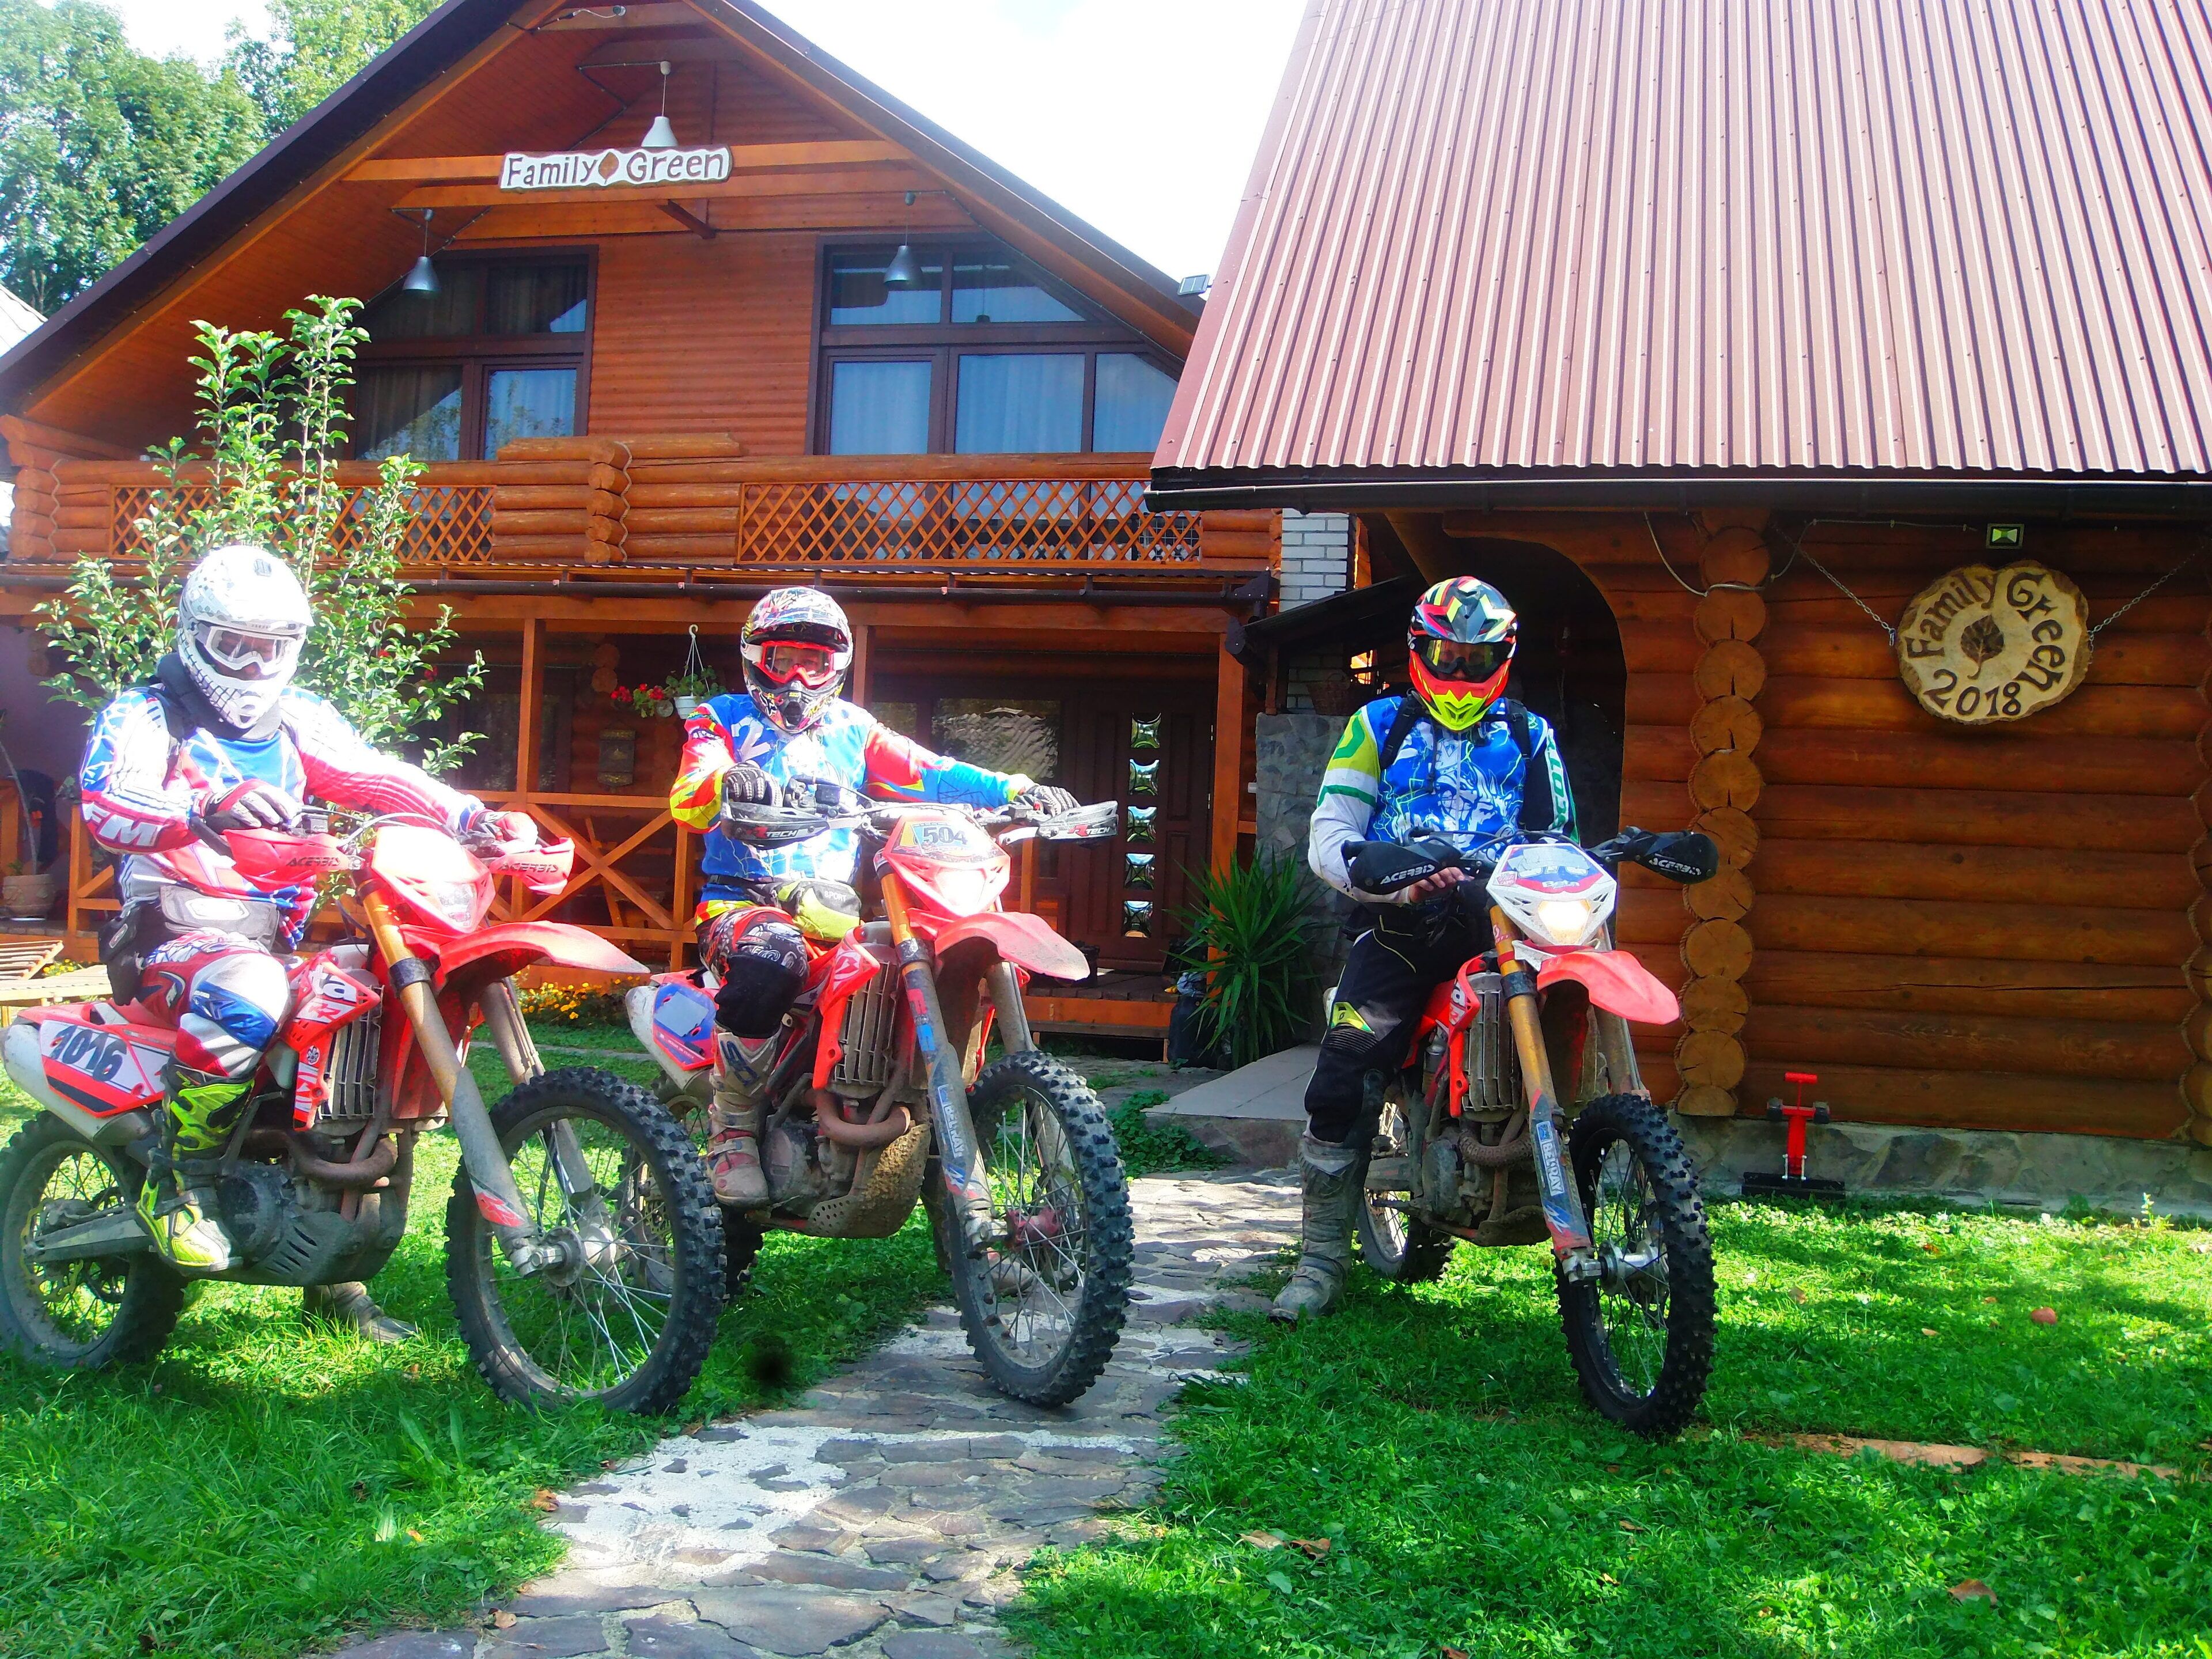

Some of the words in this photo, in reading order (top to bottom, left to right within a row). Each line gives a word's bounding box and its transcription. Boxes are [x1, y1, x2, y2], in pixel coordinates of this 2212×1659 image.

[507, 156, 599, 186] Family
[627, 151, 724, 182] Green
[1904, 573, 1998, 658] Family
[2006, 571, 2066, 691] Green
[1923, 668, 2022, 717] 2018
[923, 827, 968, 846] 504
[1380, 864, 1435, 884] ACERBIS
[50, 1025, 127, 1082] 1016
